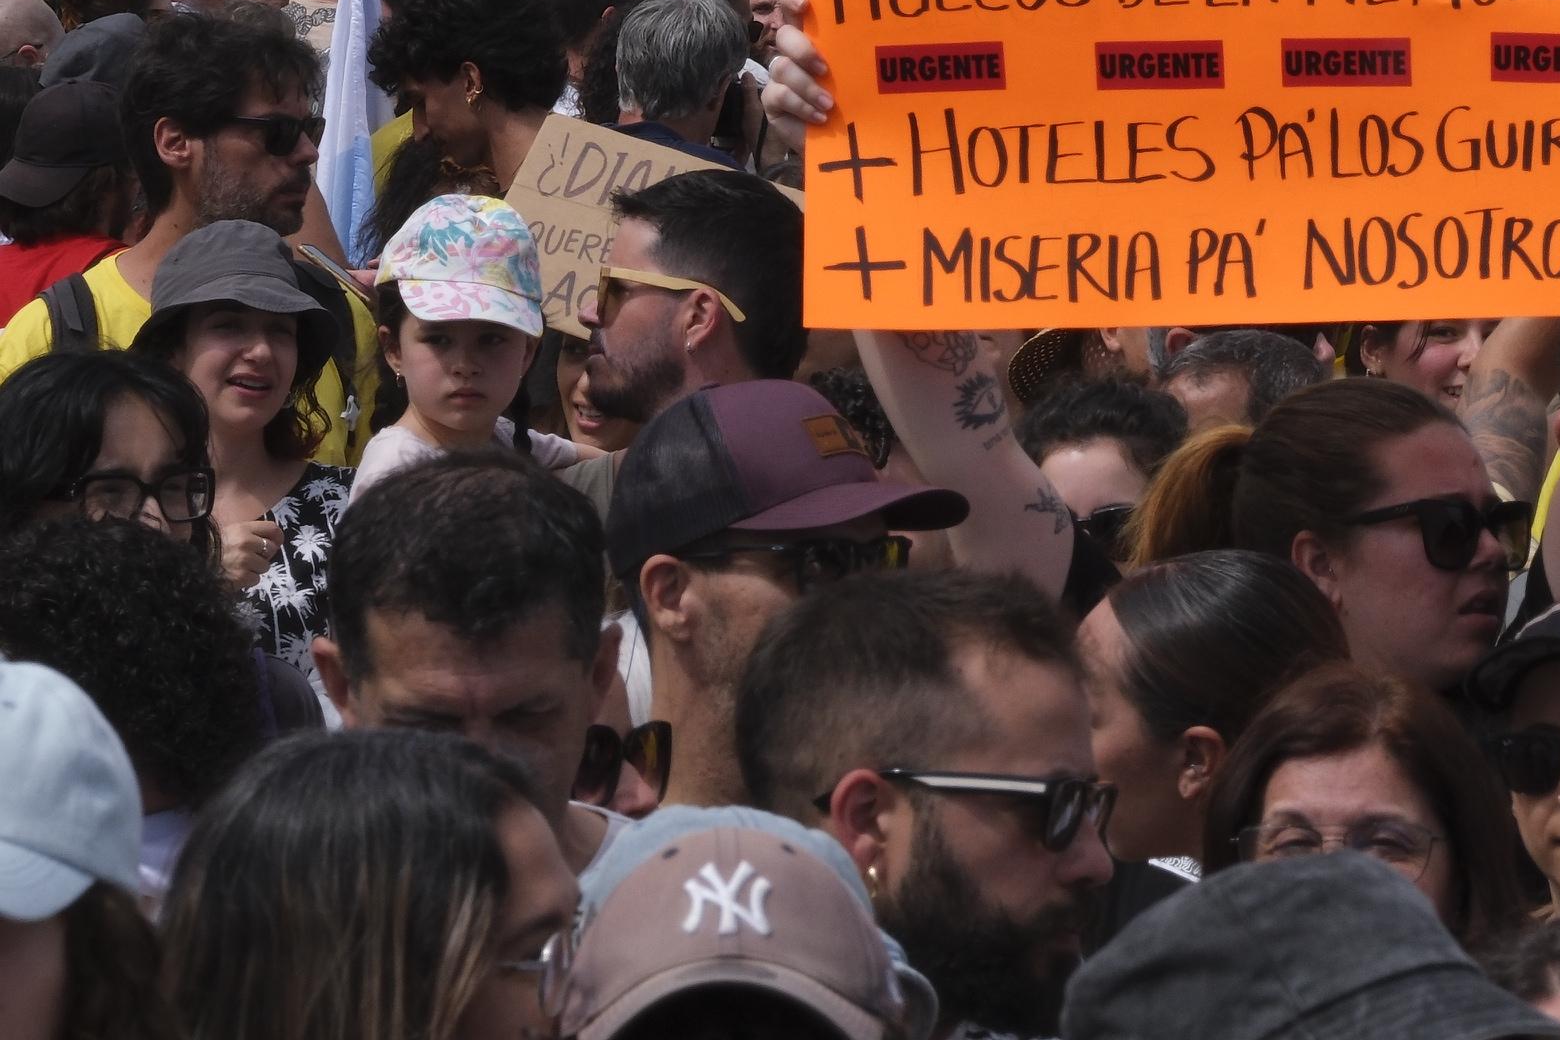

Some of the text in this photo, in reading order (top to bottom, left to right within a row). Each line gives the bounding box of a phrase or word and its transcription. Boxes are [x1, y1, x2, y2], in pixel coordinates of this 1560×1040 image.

[880, 53, 1001, 83] URGENTE
[1100, 52, 1220, 80] URGENTE
[1285, 49, 1407, 78] URGENTE
[908, 109, 1216, 197] HOTELES
[1330, 110, 1424, 178] LOS
[923, 226, 1161, 305] MISERIA
[682, 858, 771, 936] NY
